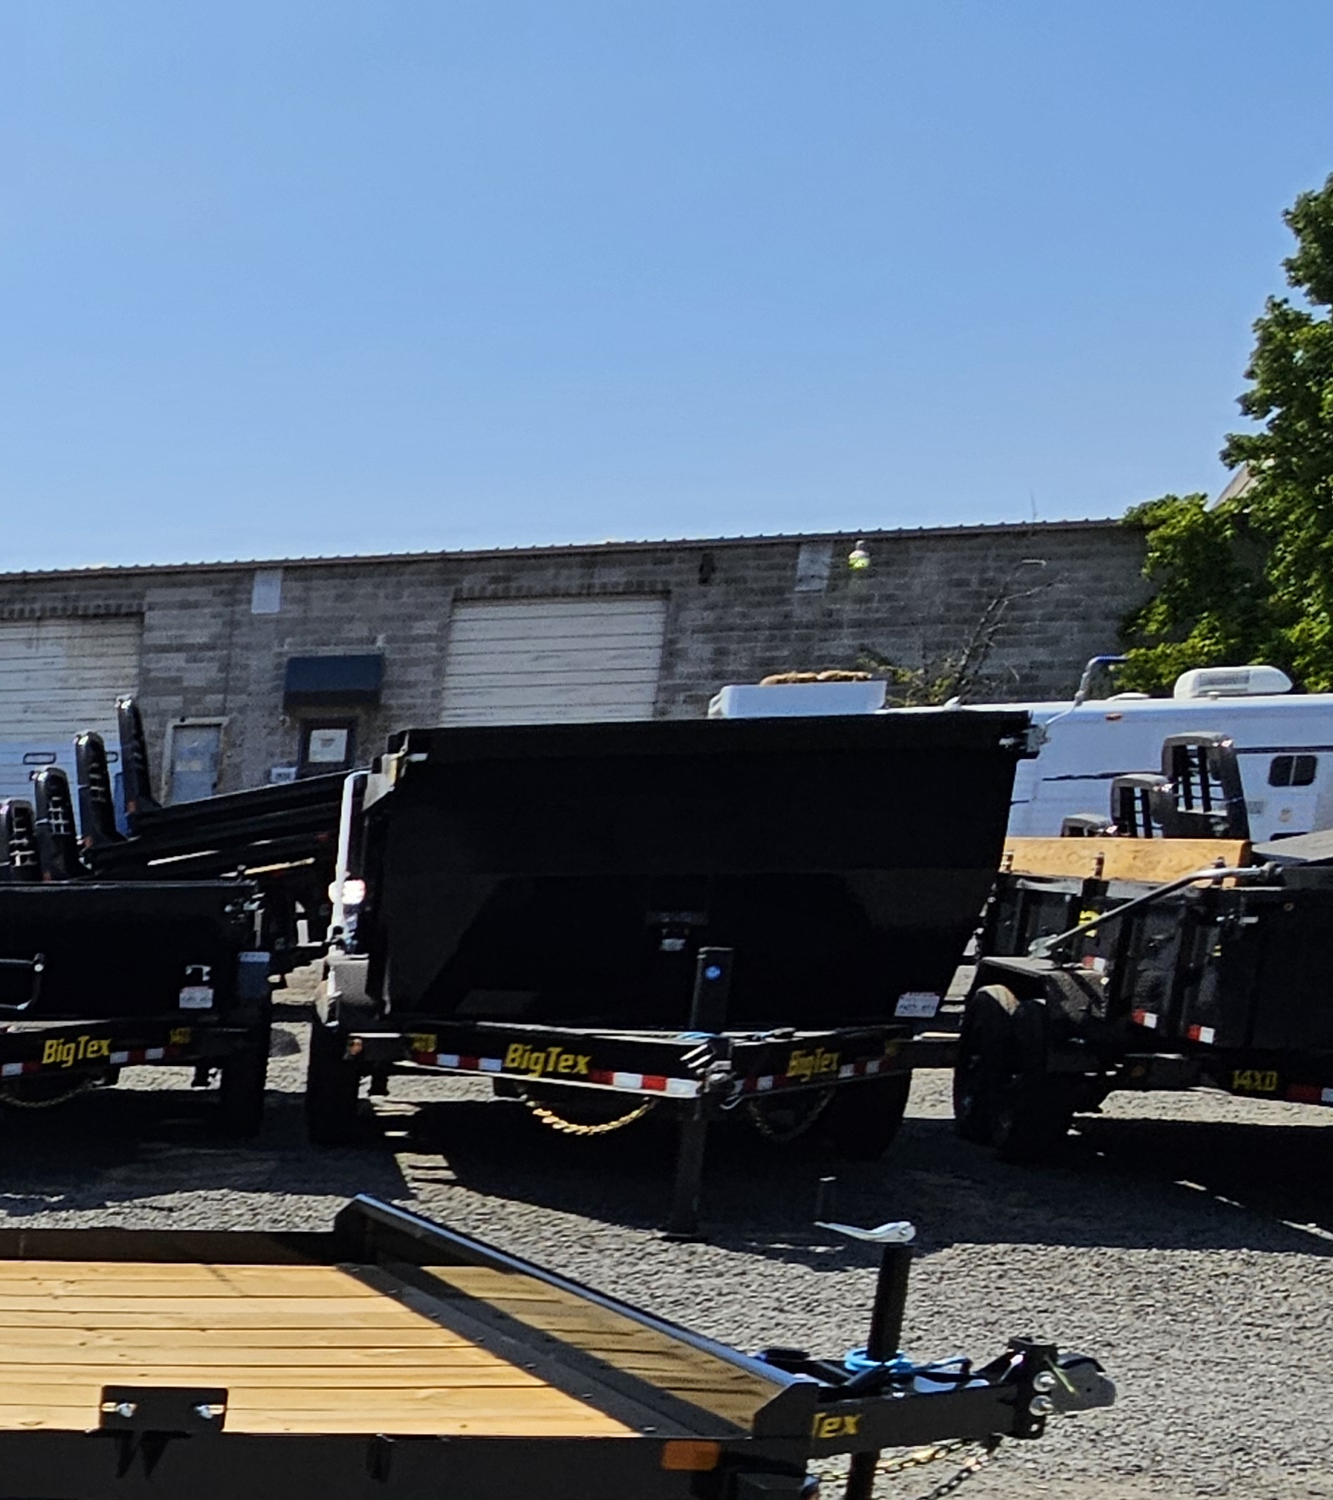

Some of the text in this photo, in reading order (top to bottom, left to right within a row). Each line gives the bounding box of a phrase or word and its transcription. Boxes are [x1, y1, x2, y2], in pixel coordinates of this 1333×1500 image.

[42, 1036, 111, 1067] BigTex
[505, 1043, 592, 1075] BigTex
[785, 1046, 841, 1082] BigTex
